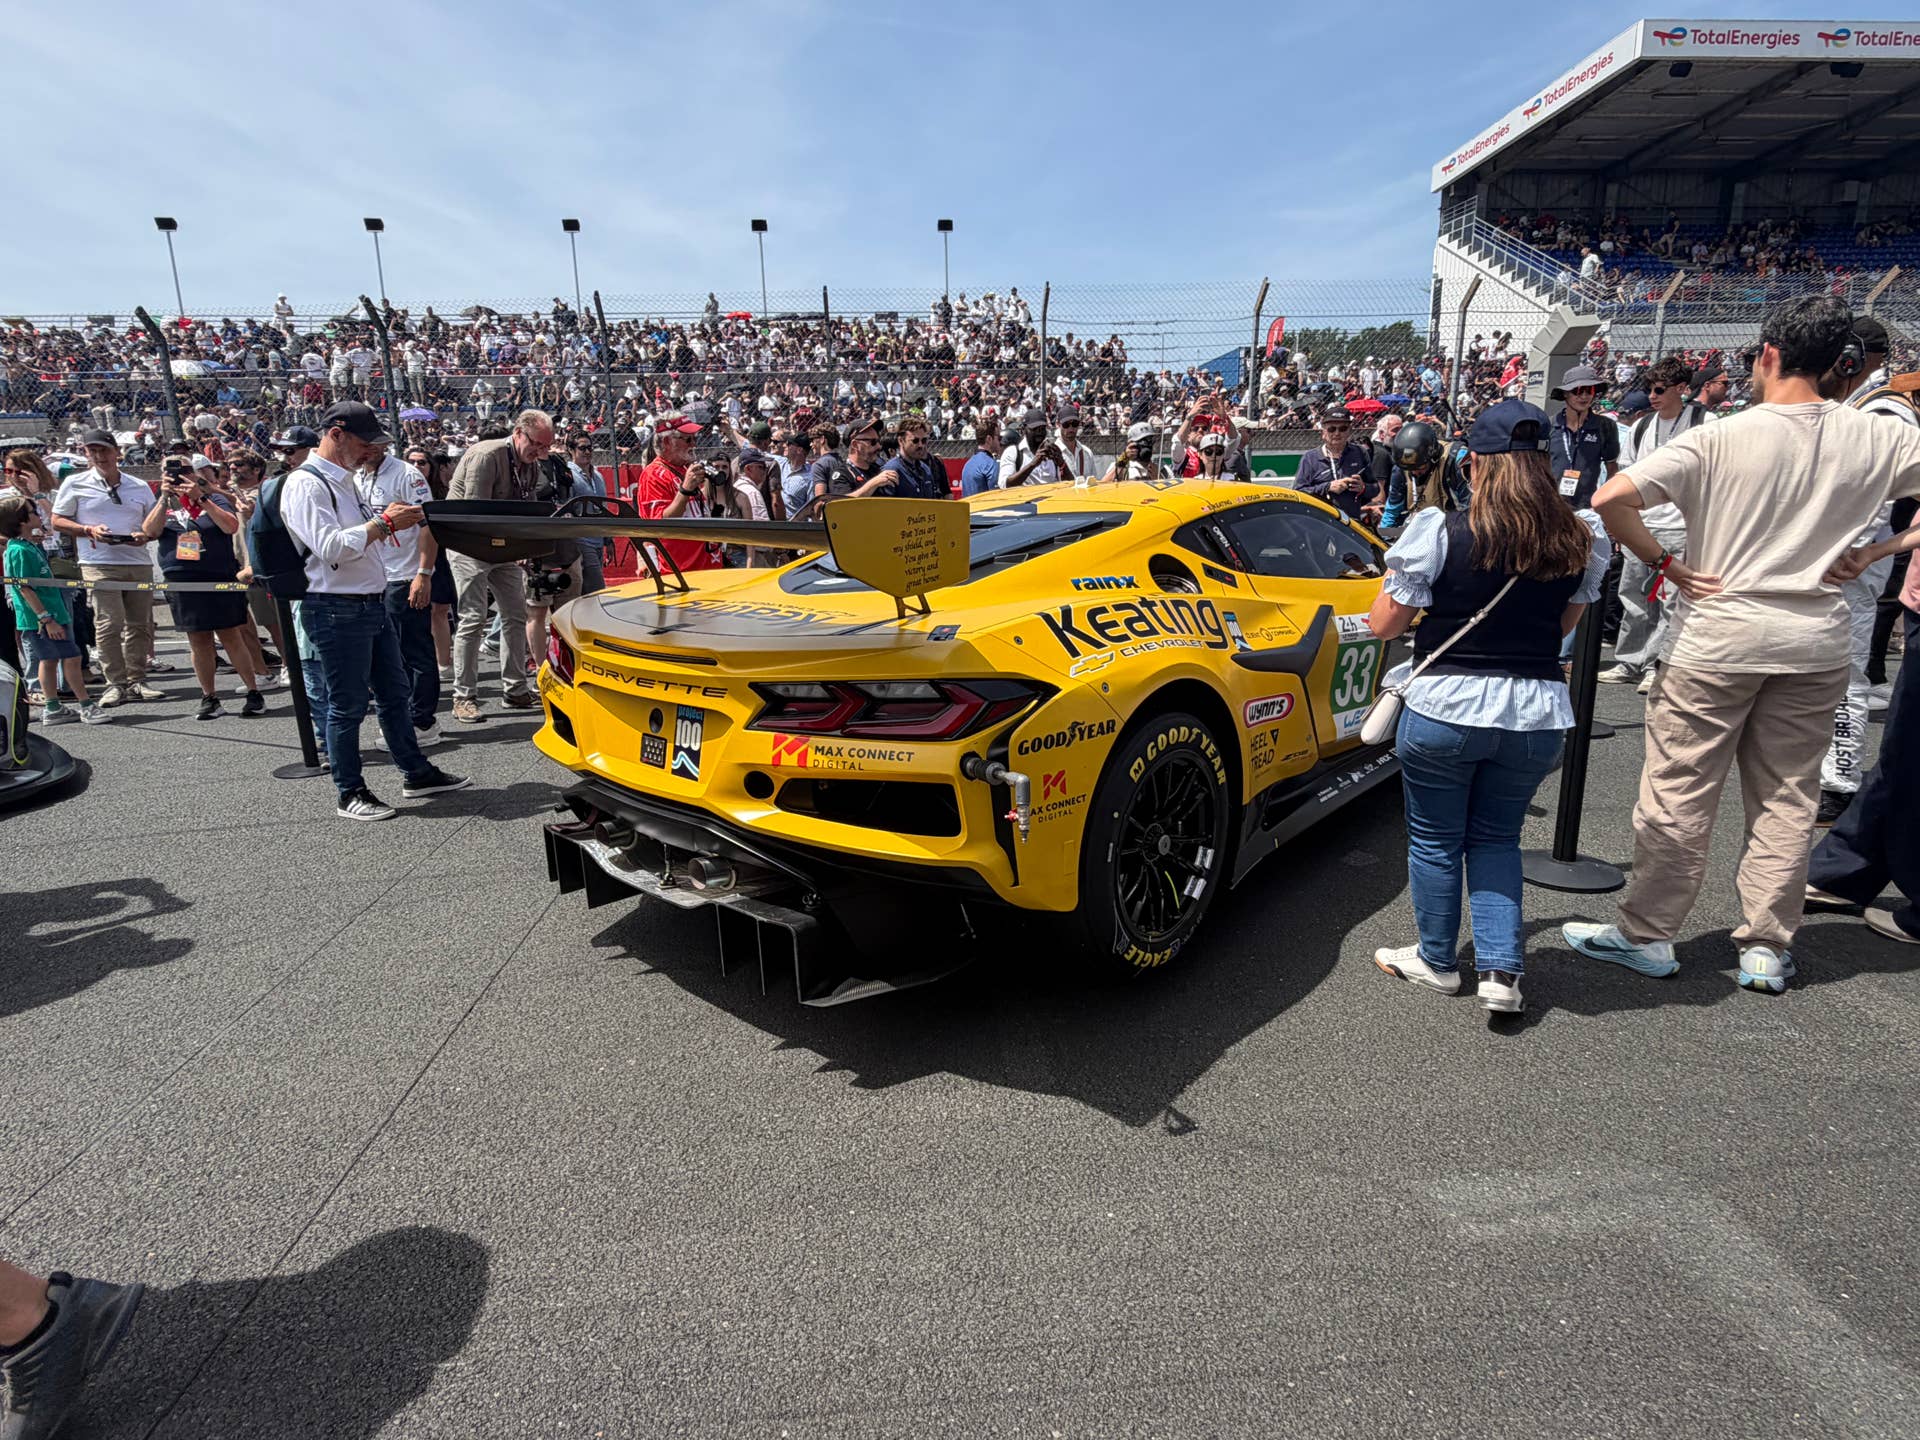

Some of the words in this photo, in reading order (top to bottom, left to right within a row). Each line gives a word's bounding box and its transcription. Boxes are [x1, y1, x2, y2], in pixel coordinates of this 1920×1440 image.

[1690, 29, 1800, 49] TotalEnergies
[1543, 52, 1614, 108] TotalEnergies
[1457, 123, 1510, 166] TotalEnergies
[1213, 526, 1230, 548] OPEN
[1034, 596, 1229, 658] Keating
[1339, 616, 1357, 632] 24h
[1120, 637, 1203, 657] CHEVROLET
[581, 661, 728, 698] CORVETTE
[1335, 645, 1375, 707] 33
[678, 705, 704, 720] project
[675, 719, 701, 750] 100
[1018, 719, 1116, 756] GOODYEAR
[1250, 730, 1268, 752] HEEL
[815, 745, 843, 757] MAX
[848, 747, 914, 762] CONNECT
[1146, 726, 1227, 785] GOODYEAR
[1251, 749, 1275, 771] TREAD
[1836, 741, 1852, 776] HOST
[813, 759, 864, 771] DIGITAL
[1046, 794, 1087, 811] CONNECT
[1038, 809, 1072, 823] DIGITAL
[1124, 944, 1171, 967] EAGLE
